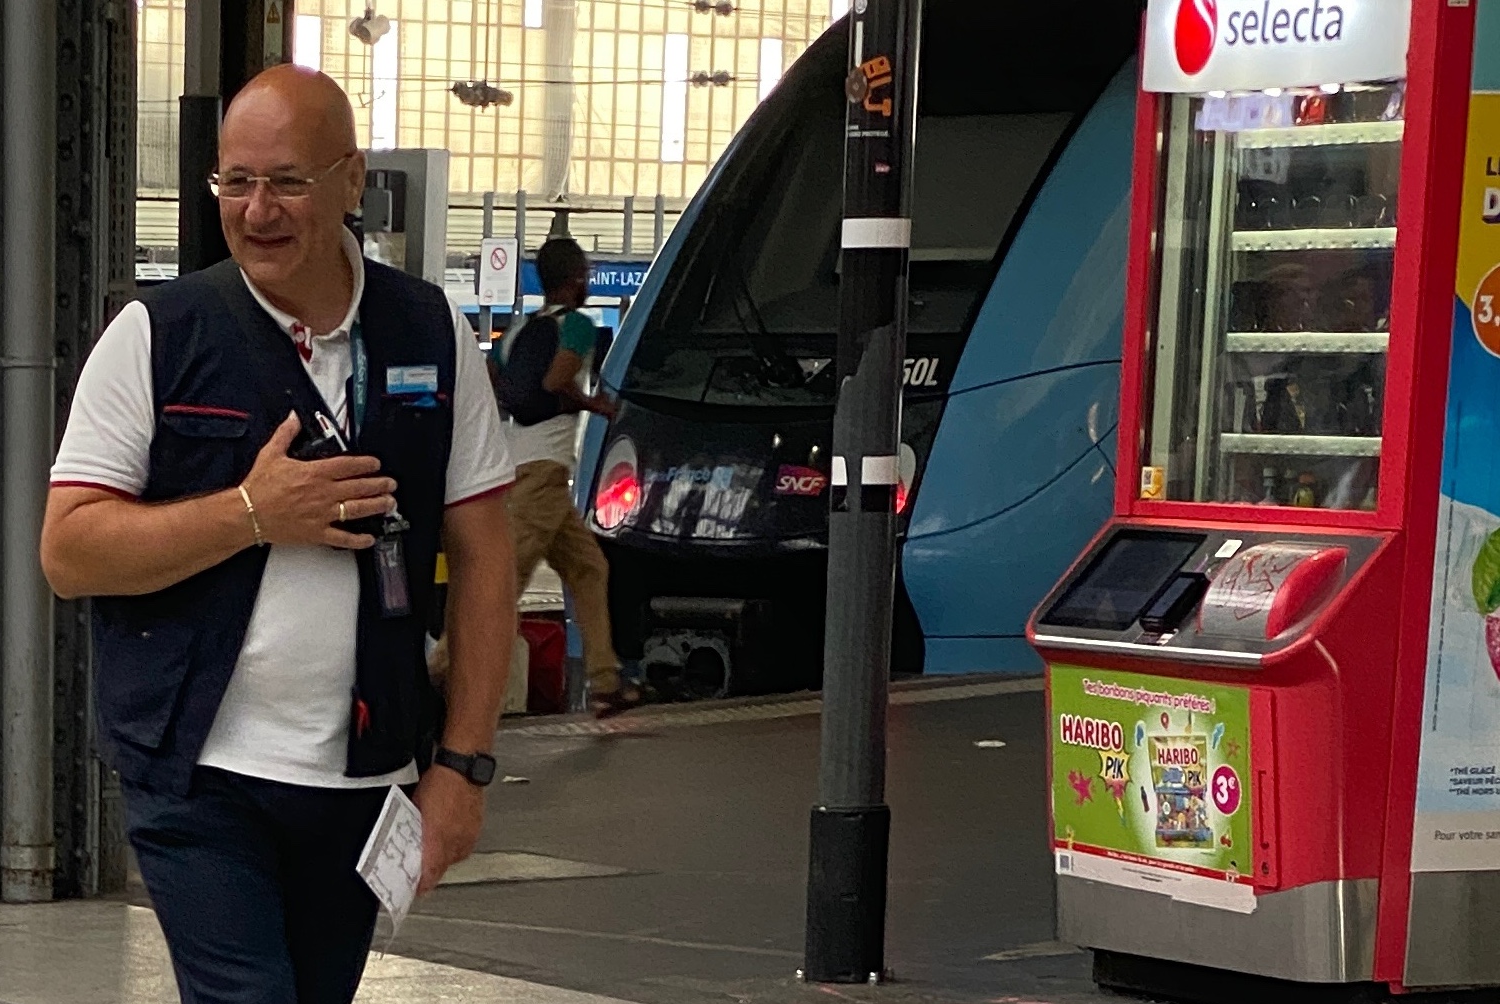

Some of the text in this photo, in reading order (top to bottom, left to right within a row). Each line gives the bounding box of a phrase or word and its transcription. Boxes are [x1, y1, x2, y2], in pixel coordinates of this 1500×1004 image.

[1224, 0, 1344, 46] selecta
[589, 271, 646, 286] AINT-LAZ
[776, 475, 822, 492] SNCF
[1098, 681, 1135, 701] bonbons
[1135, 686, 1172, 707] piquants
[1173, 692, 1211, 713] préférés
[1062, 714, 1123, 751] HARIBO
[1157, 747, 1199, 765] HARIBO
[1434, 830, 1456, 841] Pour
[1458, 830, 1484, 840] votre
